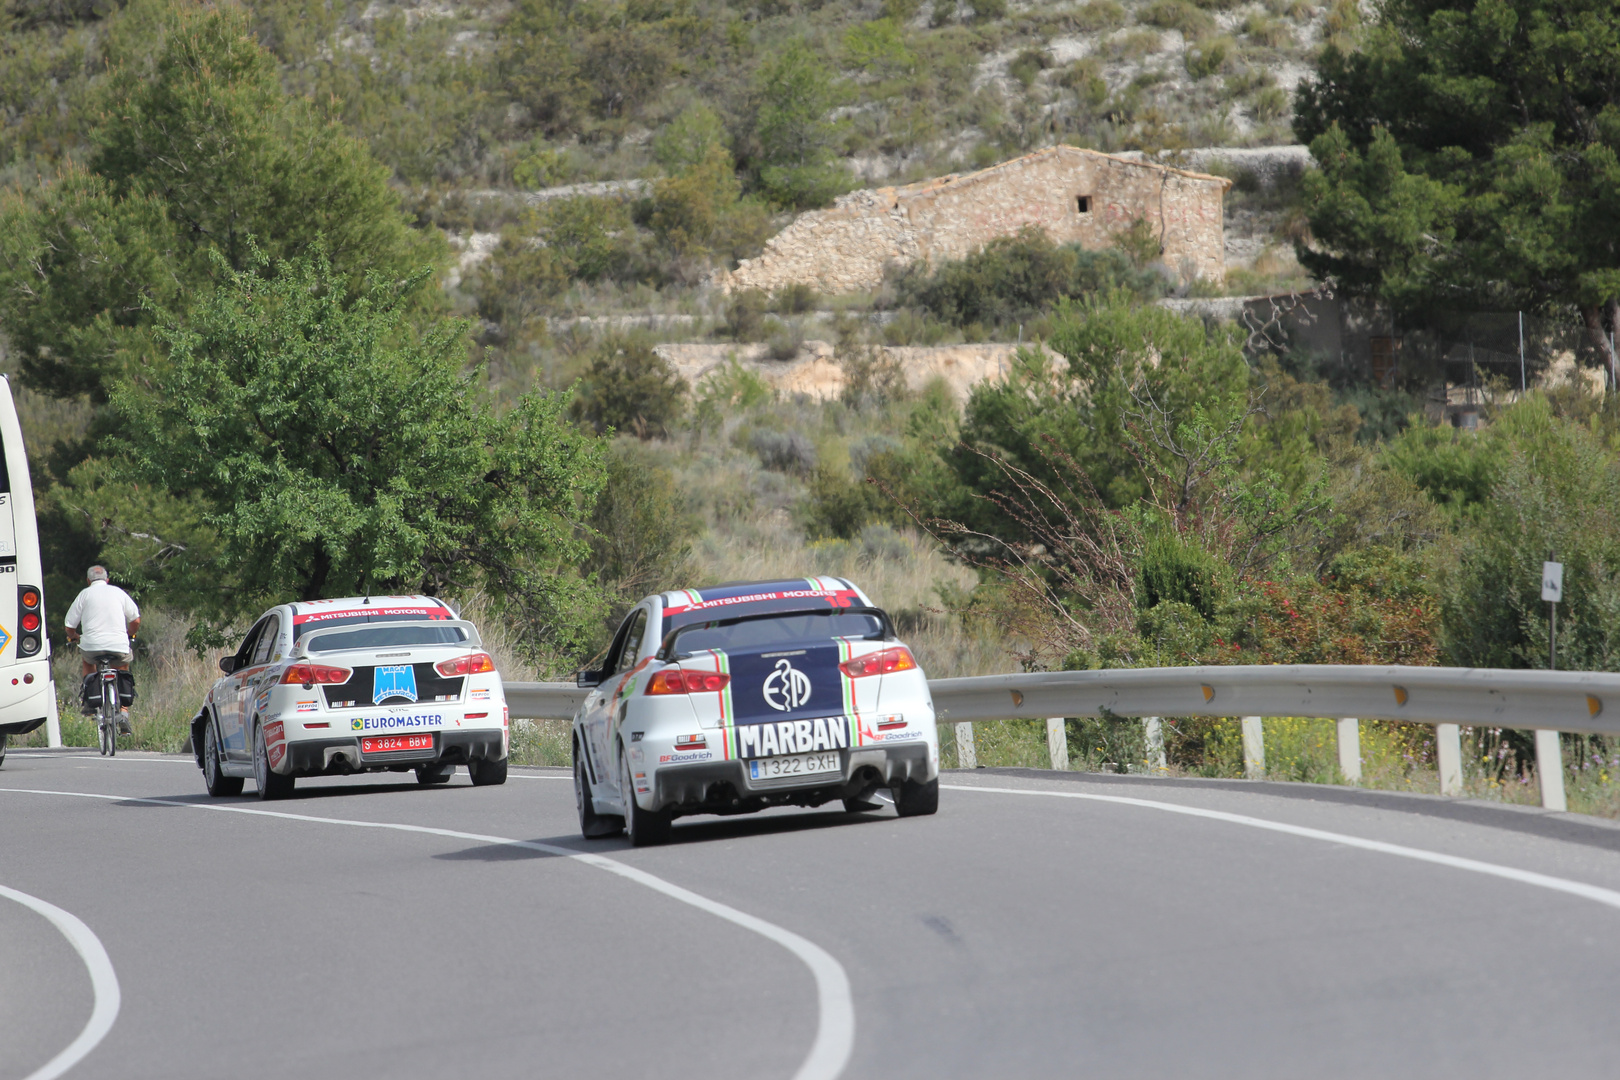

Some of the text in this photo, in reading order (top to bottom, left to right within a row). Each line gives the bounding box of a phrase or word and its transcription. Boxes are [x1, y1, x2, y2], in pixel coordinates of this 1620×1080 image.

[702, 589, 837, 608] MITSUBISHI MOTORS
[824, 596, 852, 608] 15
[320, 608, 428, 620] MITSUBISHI MOTORS
[364, 714, 442, 729] EUROMASTER
[738, 716, 847, 758] MARBAN
[872, 730, 923, 741] BFGoodrich
[377, 738, 402, 749] 3824
[659, 751, 713, 763] BFGoodrich
[761, 754, 837, 776] 1322 GXH
